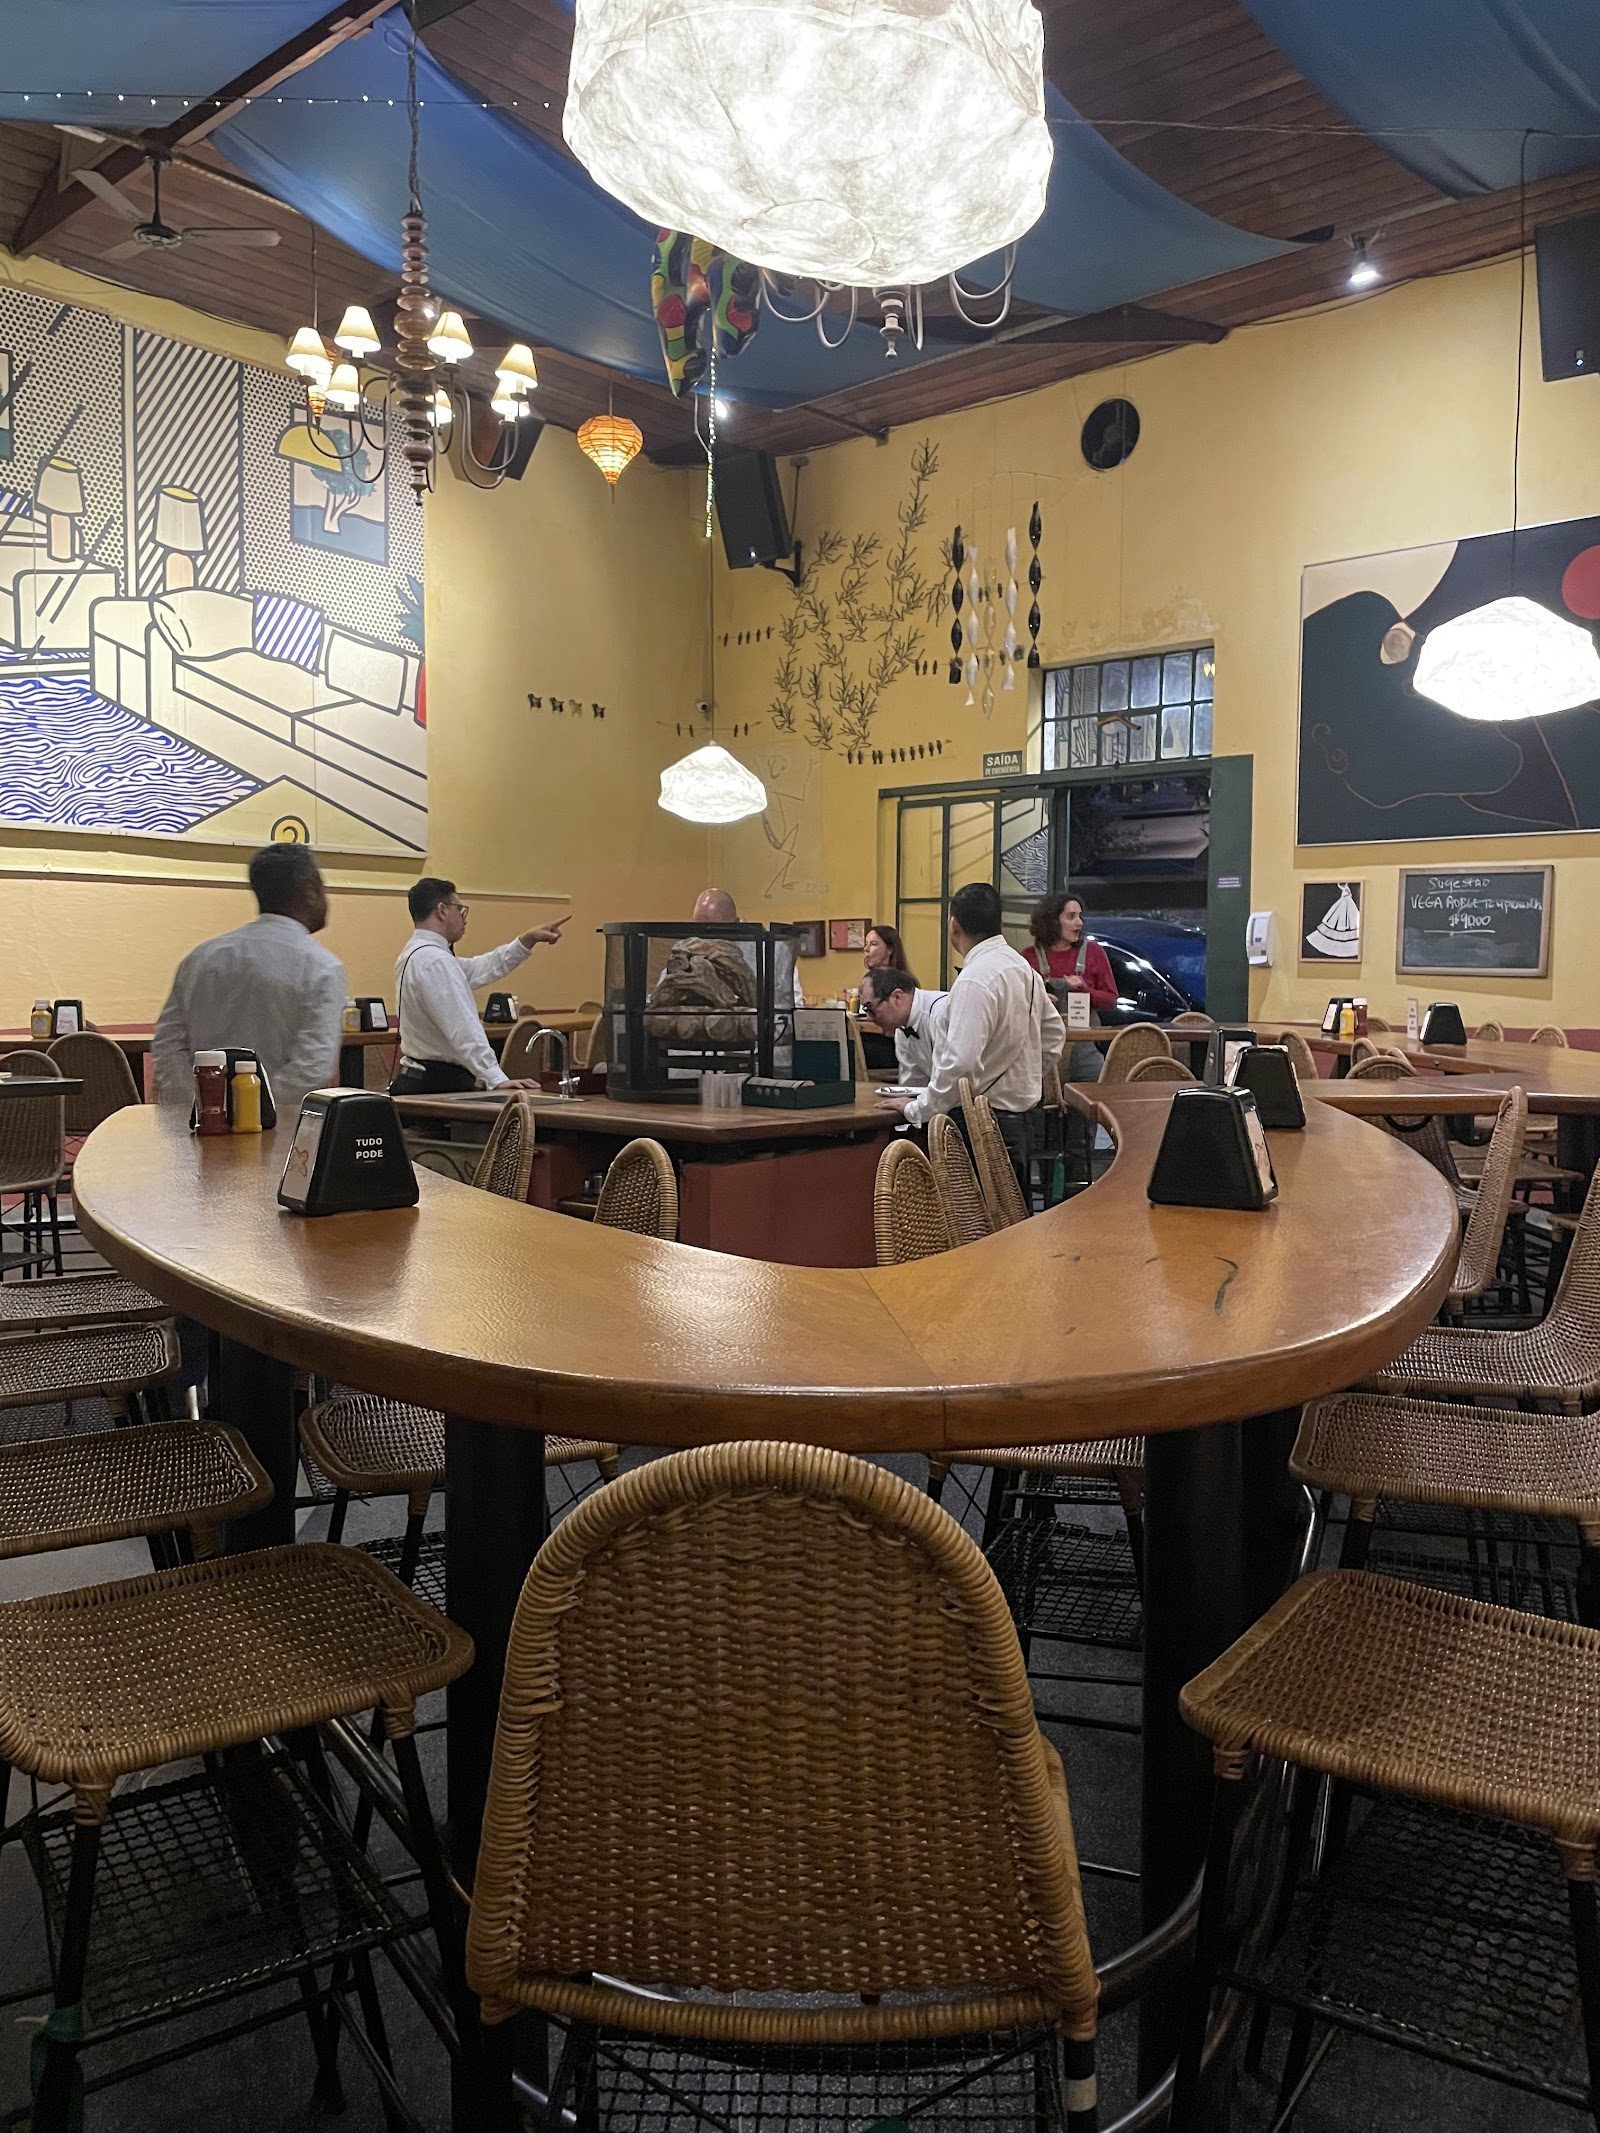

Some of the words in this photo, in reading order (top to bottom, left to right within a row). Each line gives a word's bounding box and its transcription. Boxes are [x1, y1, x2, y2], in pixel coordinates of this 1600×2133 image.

[986, 754, 1019, 767] SAÍDA
[1411, 893, 1443, 909] VEGA
[355, 1137, 383, 1147] TUDO
[355, 1149, 384, 1160] PODE
